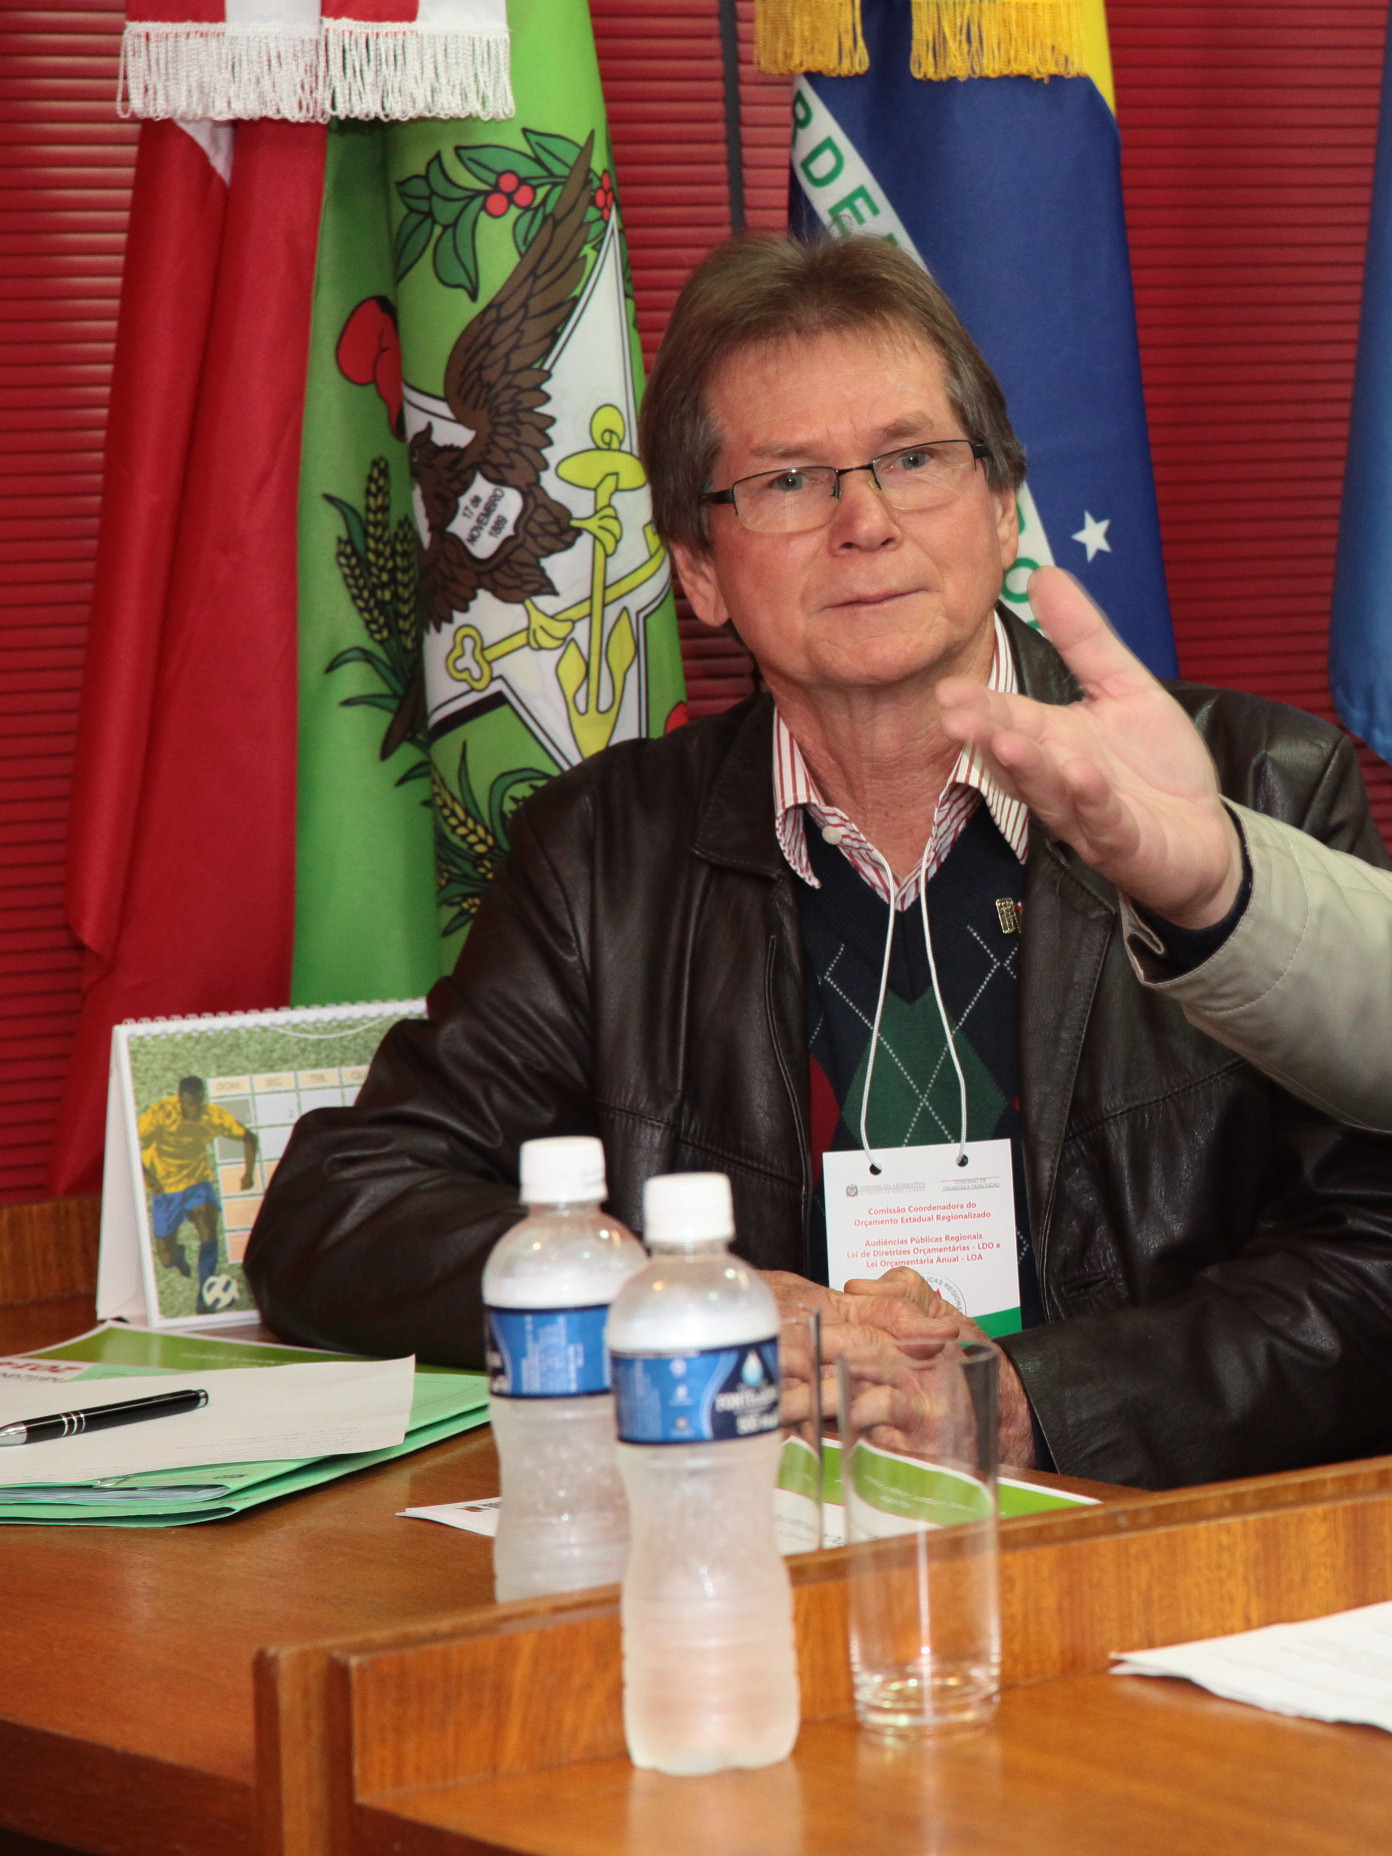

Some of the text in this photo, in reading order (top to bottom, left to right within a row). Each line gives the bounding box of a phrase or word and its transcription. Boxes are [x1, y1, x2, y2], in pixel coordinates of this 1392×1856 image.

[793, 88, 899, 246] RDE
[868, 1201, 977, 1215] Comissão Coordenadora do
[854, 1210, 992, 1228] Orçamento Estadual Regionalizado
[865, 1232, 983, 1247] Audiências Públicas Regionais
[847, 1251, 858, 1259] Lei
[860, 1250, 871, 1258] de
[873, 1248, 911, 1257] Diretrizes
[913, 1244, 970, 1256] Orçamentárias
[977, 1242, 994, 1250] LDO
[866, 1260, 878, 1268] Lei
[880, 1257, 934, 1269] Orçamentária
[936, 1255, 959, 1264] Anual
[966, 1253, 983, 1262] LOA
